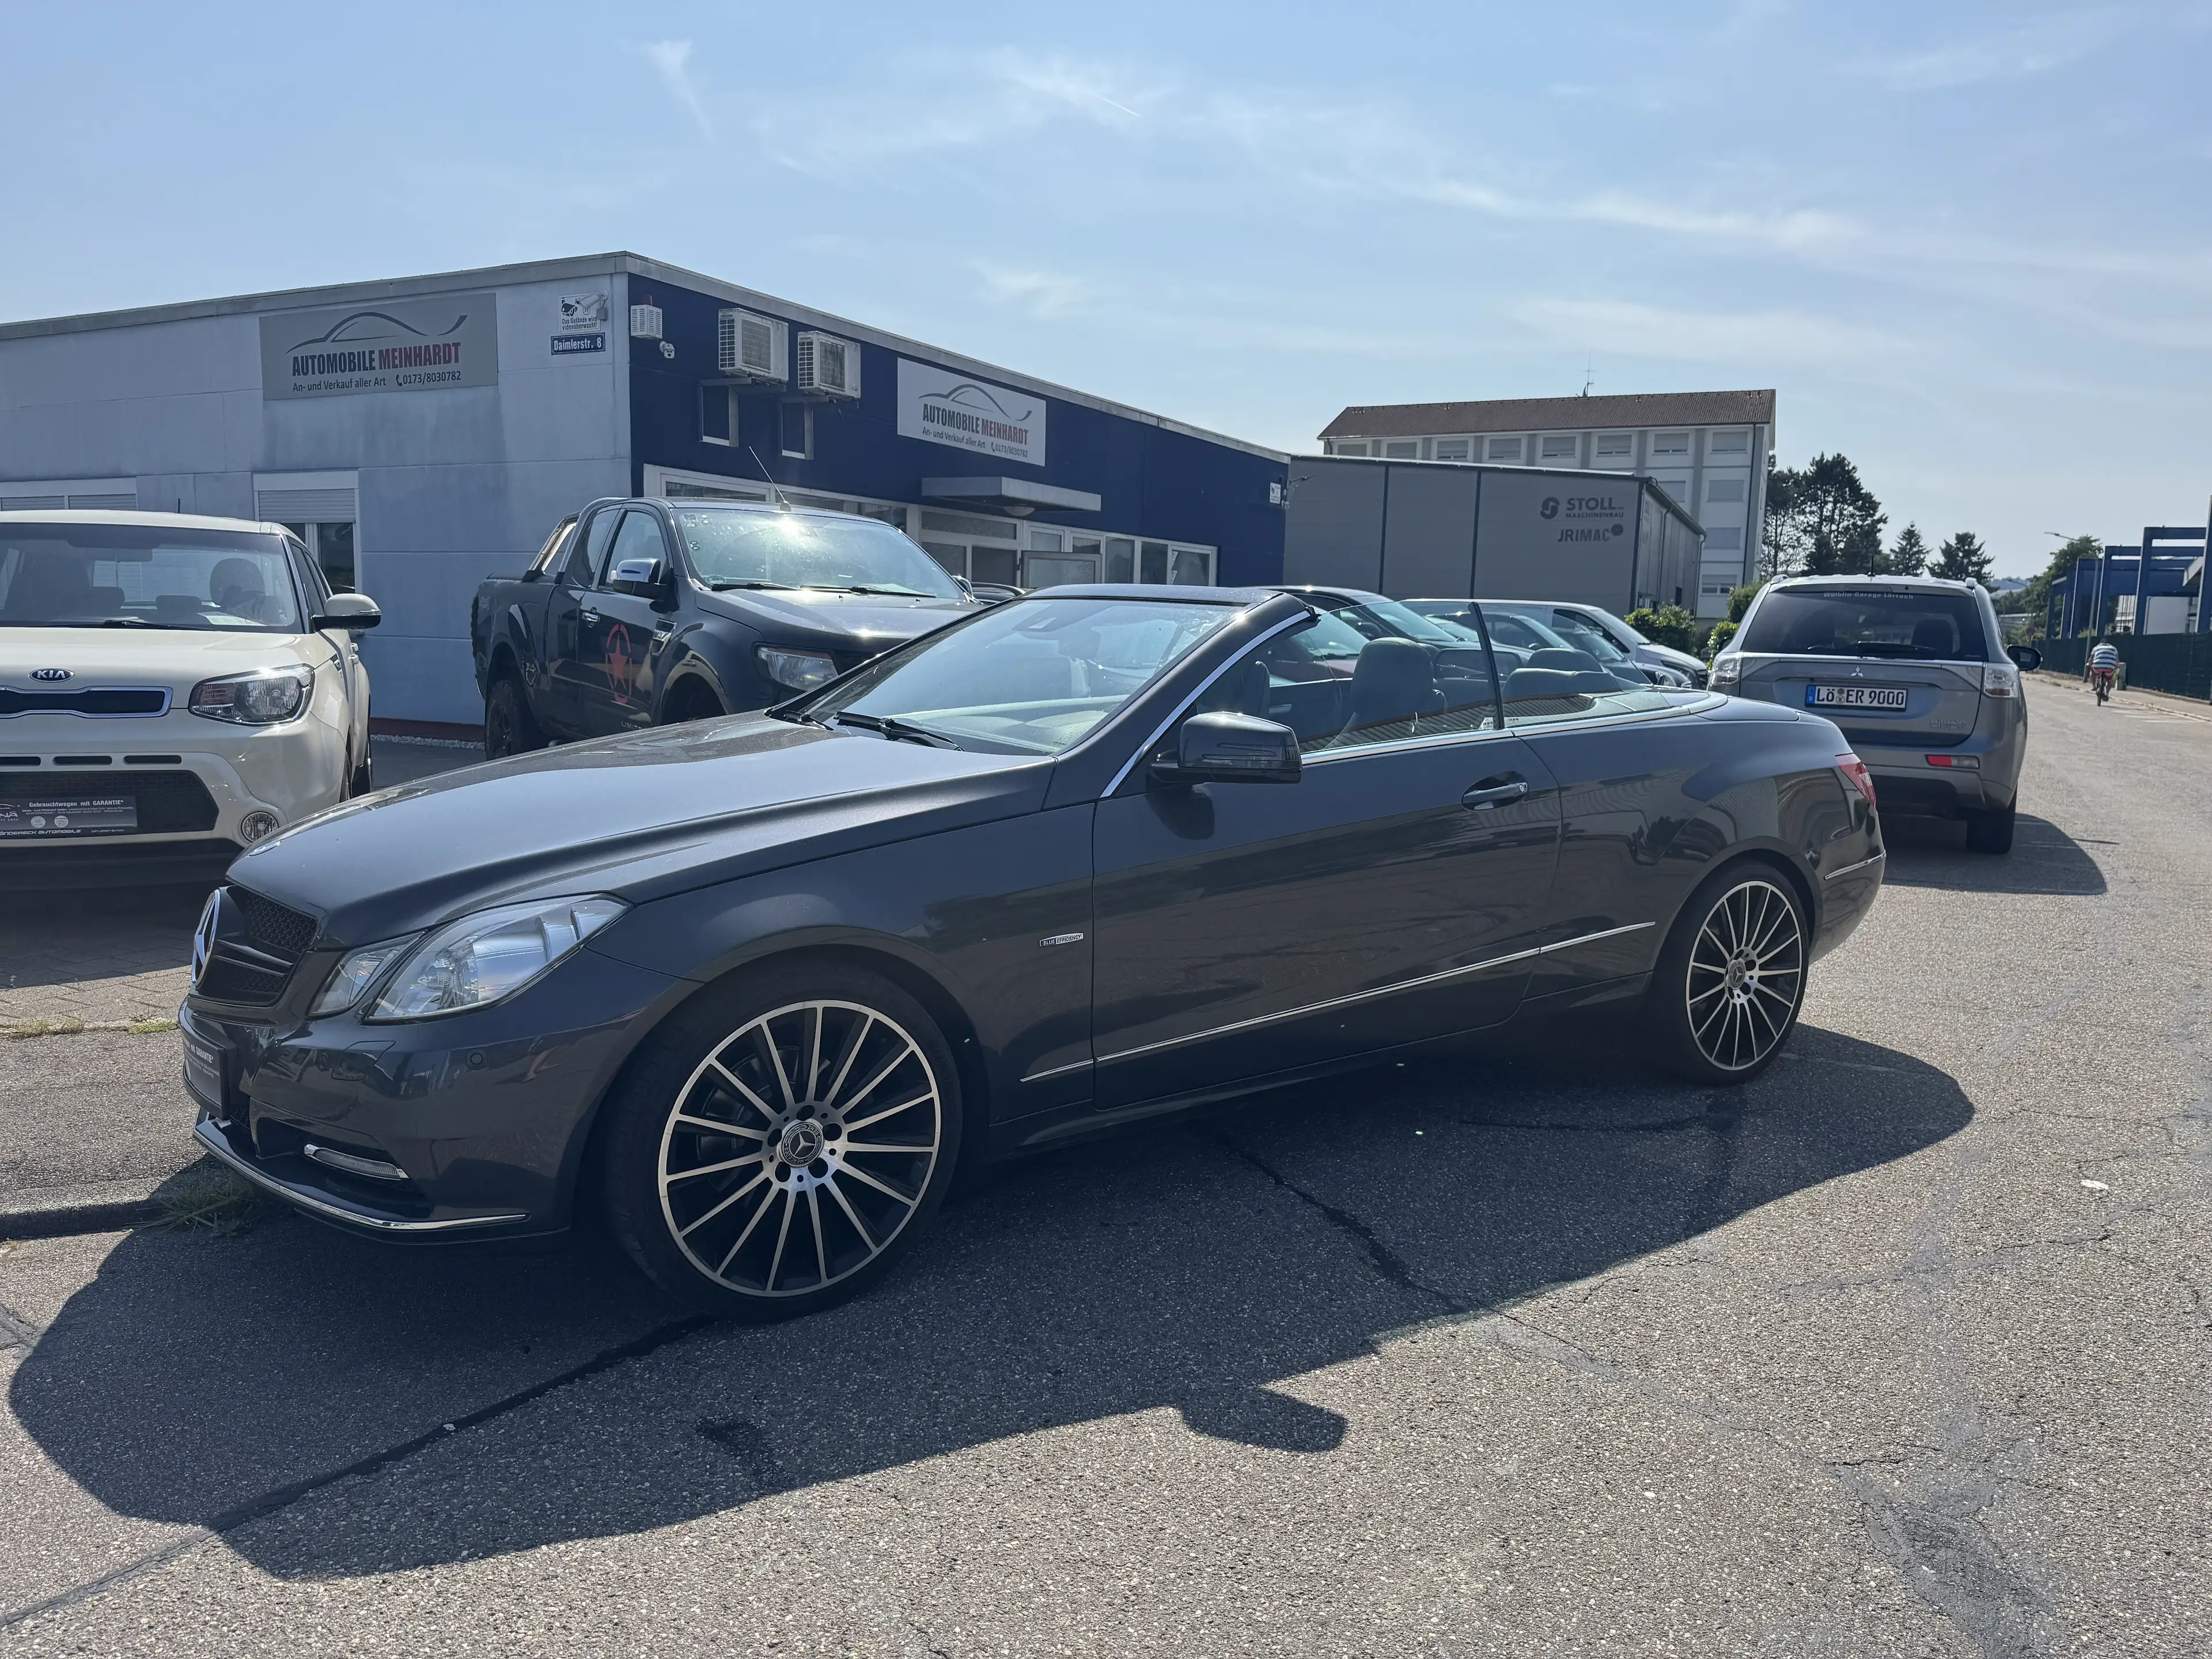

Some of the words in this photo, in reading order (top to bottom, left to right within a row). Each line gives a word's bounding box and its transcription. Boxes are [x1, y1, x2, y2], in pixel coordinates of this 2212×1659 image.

[554, 339, 593, 351] Daimlerstr.
[597, 337, 601, 348] 8
[292, 350, 376, 376] AUTOMOBILE
[378, 342, 461, 370] MEINHARDT
[293, 382, 306, 392] An-
[308, 380, 321, 391] und
[323, 378, 353, 389] Verkauf
[354, 377, 372, 388] aller
[374, 377, 387, 387] Art
[403, 370, 461, 385] 0173/8030782
[922, 403, 980, 434] AUTOMOBILE
[981, 418, 1029, 445] MEINHARDT
[922, 427, 933, 436] An-
[933, 431, 944, 439] und
[944, 431, 965, 444] Verkauf
[965, 437, 977, 446] aller
[977, 440, 986, 449] Art
[995, 444, 1028, 458] 0173/8030782
[1566, 497, 1616, 511] STOLL
[37, 670, 66, 679] KIA
[1846, 690, 1864, 704] ER
[1869, 690, 1904, 706] 9000
[621, 720, 642, 730] LIMIT
